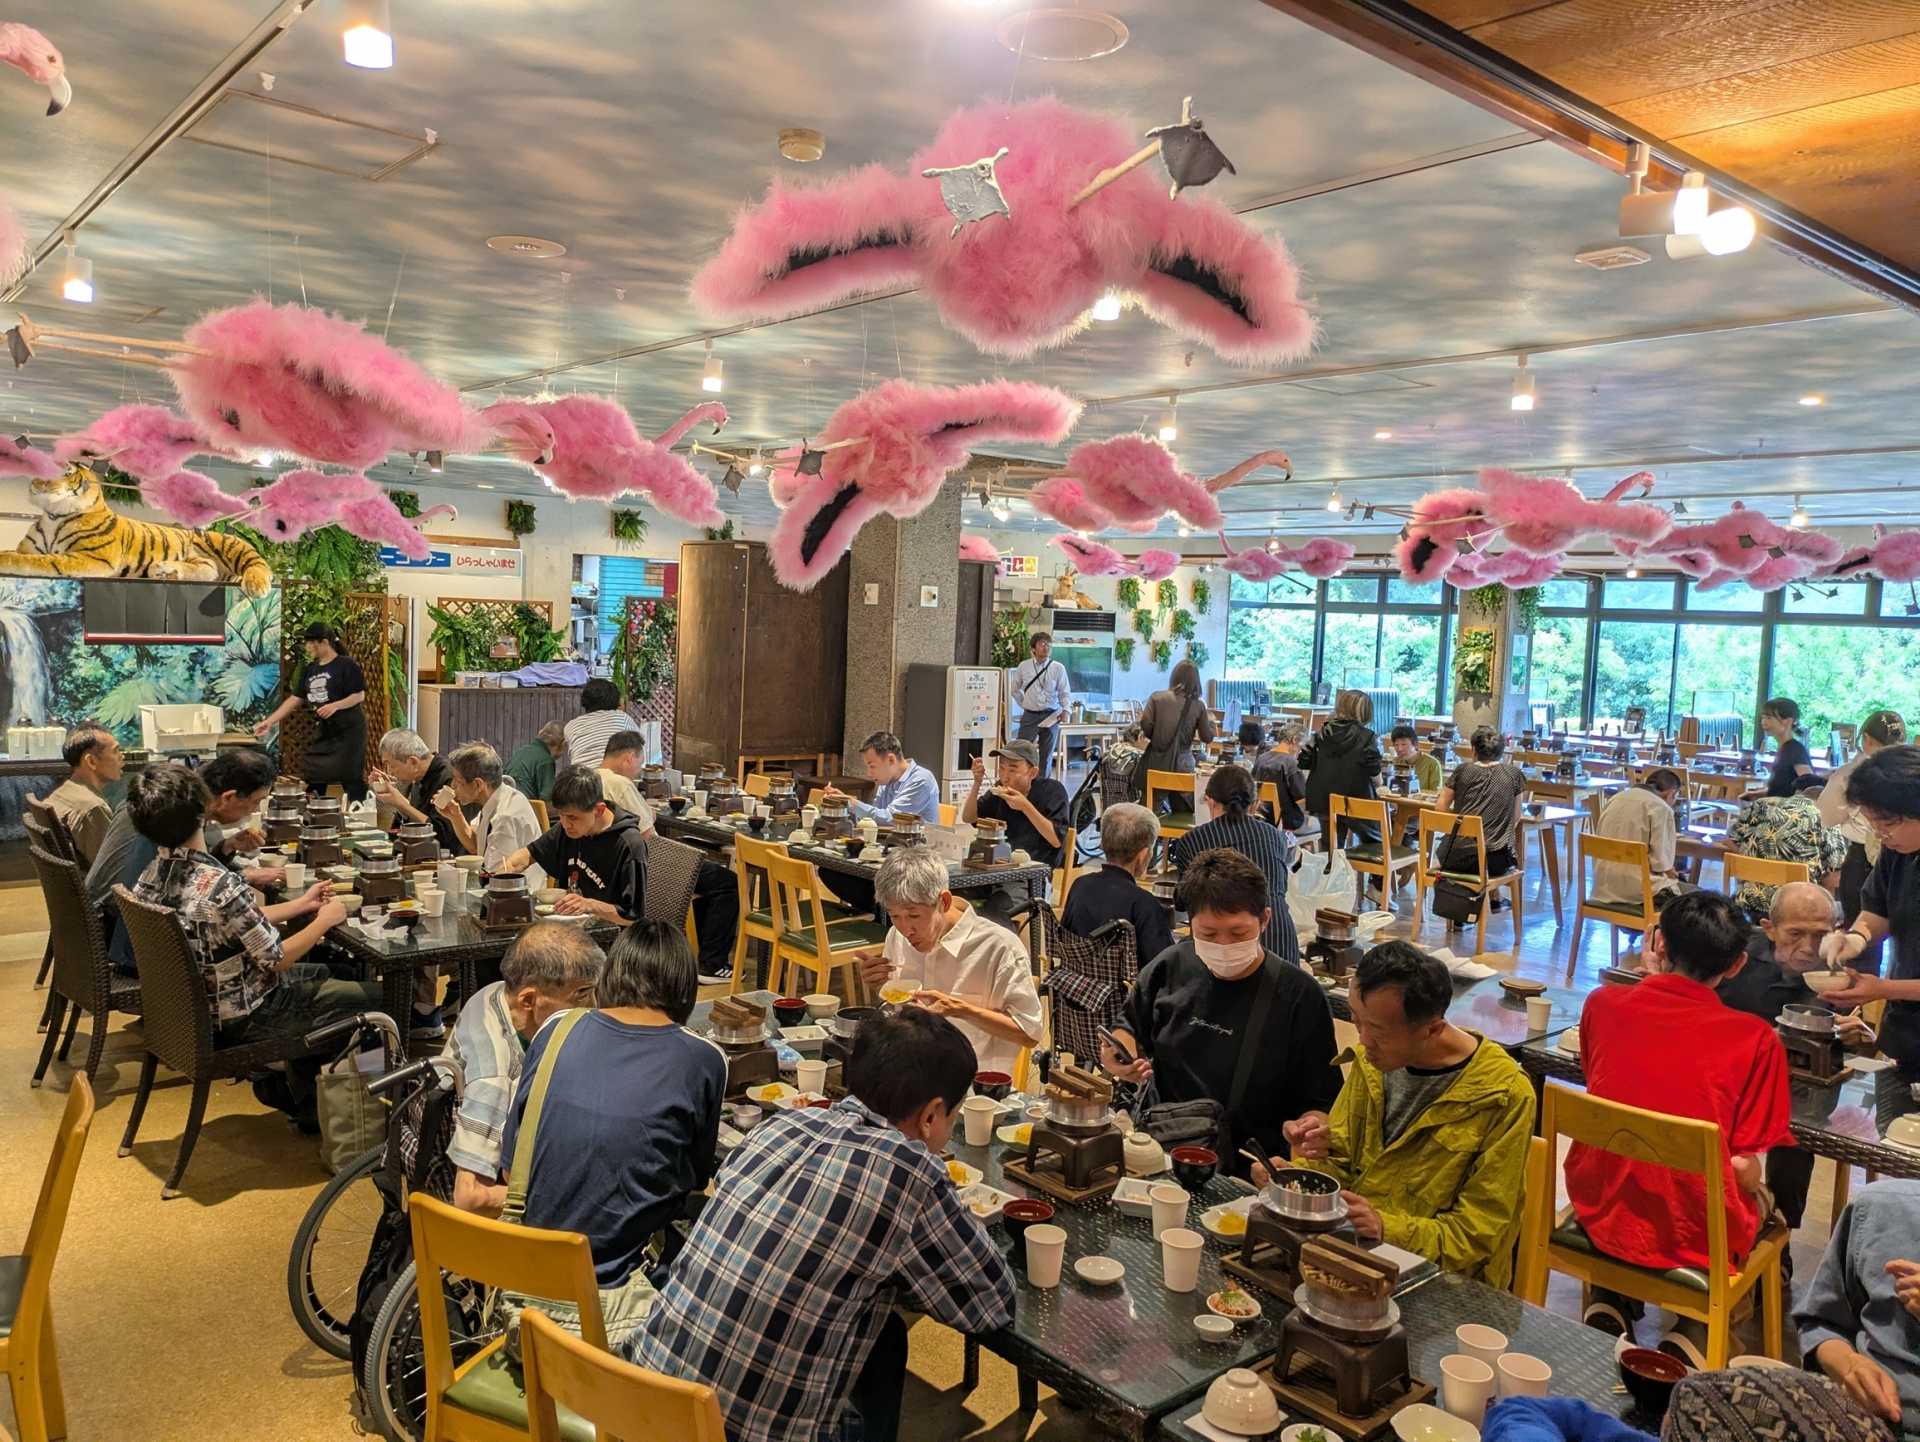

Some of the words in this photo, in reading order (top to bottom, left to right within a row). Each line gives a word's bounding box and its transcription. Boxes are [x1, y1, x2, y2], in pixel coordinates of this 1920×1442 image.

[456, 555, 516, 569] いらっしゃいませ
